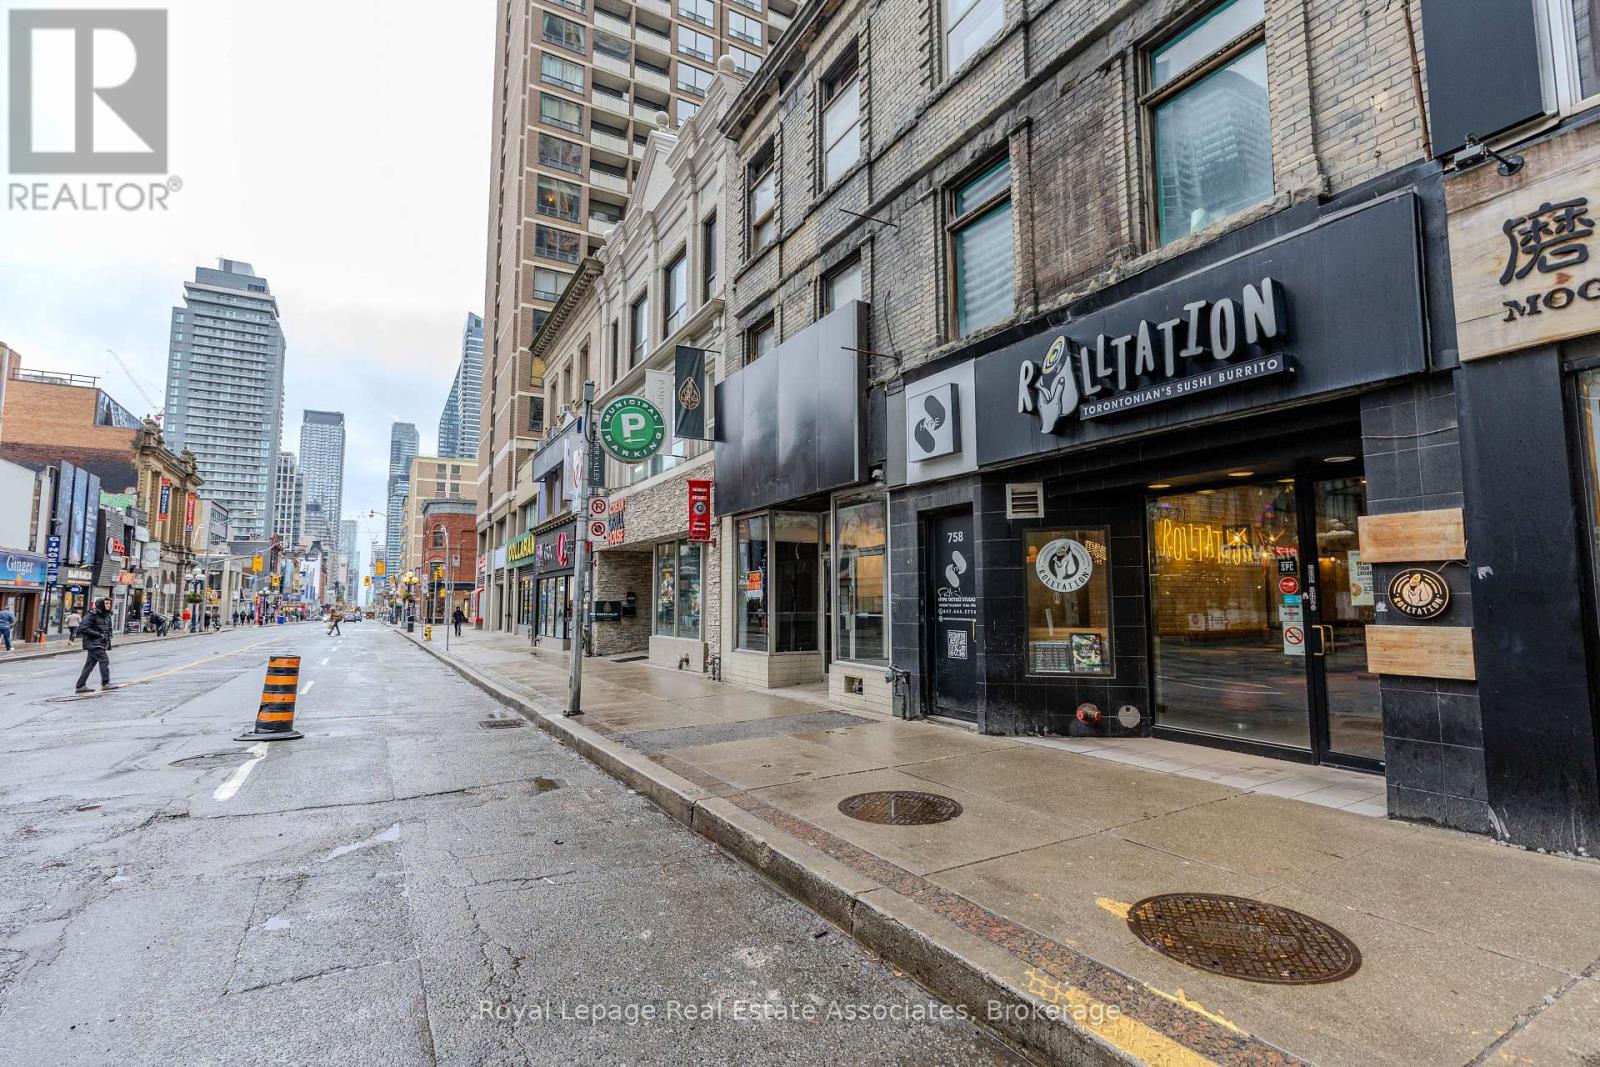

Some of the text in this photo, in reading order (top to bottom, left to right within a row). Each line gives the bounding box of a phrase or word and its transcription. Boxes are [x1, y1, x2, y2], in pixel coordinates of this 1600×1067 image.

[1083, 359, 1278, 416] TORONTONIAN'S SUSHI BURRITO
[604, 399, 660, 423] MUNICIPAL
[621, 413, 646, 440] P
[605, 432, 662, 457] PARKING
[947, 531, 964, 543] 758
[6, 555, 34, 575] Ginger
[1280, 563, 1294, 571] SPC
[1039, 569, 1090, 591] ROLLTATION
[1393, 597, 1444, 615] ROLLTATION
